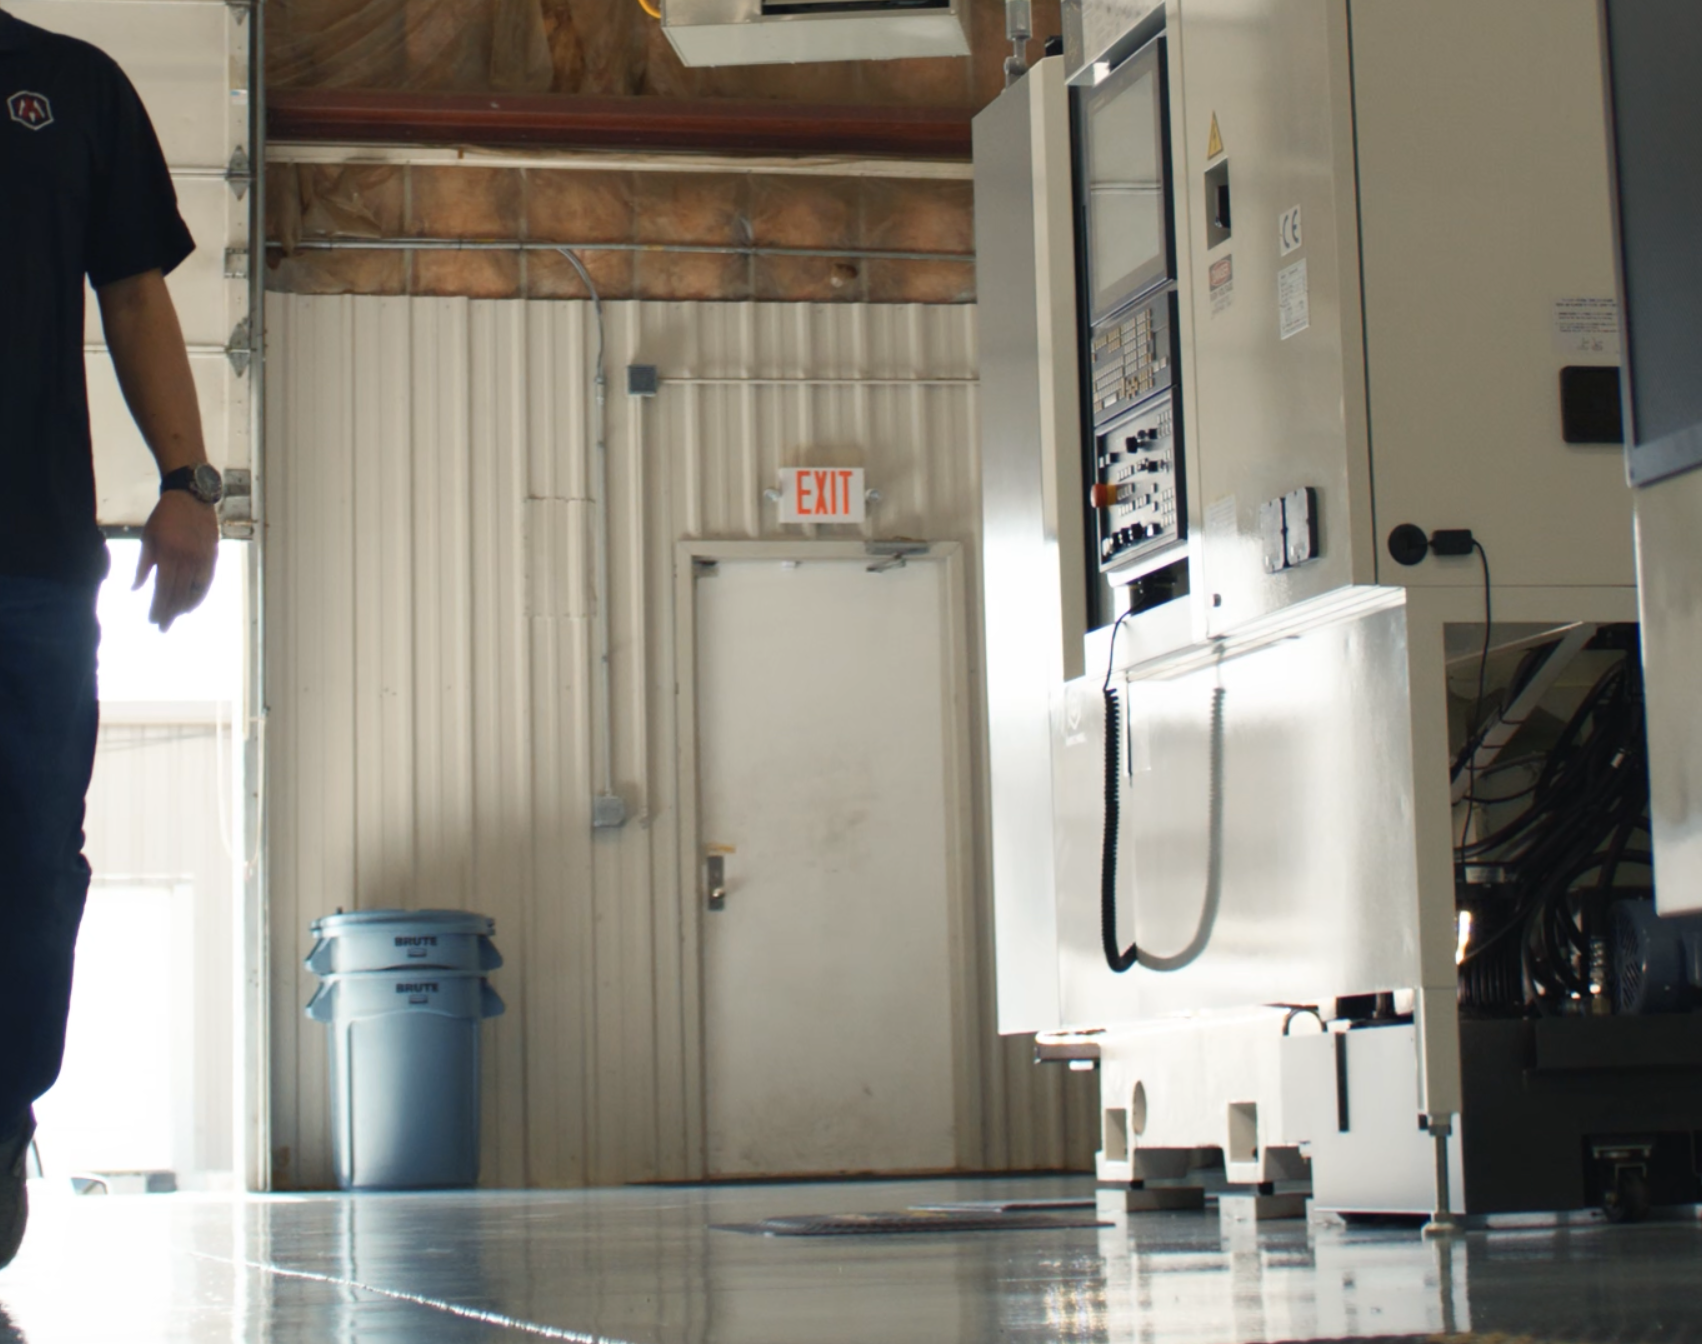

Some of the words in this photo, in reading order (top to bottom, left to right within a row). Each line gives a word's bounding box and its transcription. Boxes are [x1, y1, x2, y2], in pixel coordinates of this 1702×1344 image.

[796, 470, 853, 515] EXIT
[394, 936, 437, 947] BRUTE
[396, 983, 439, 993] BRUTE
